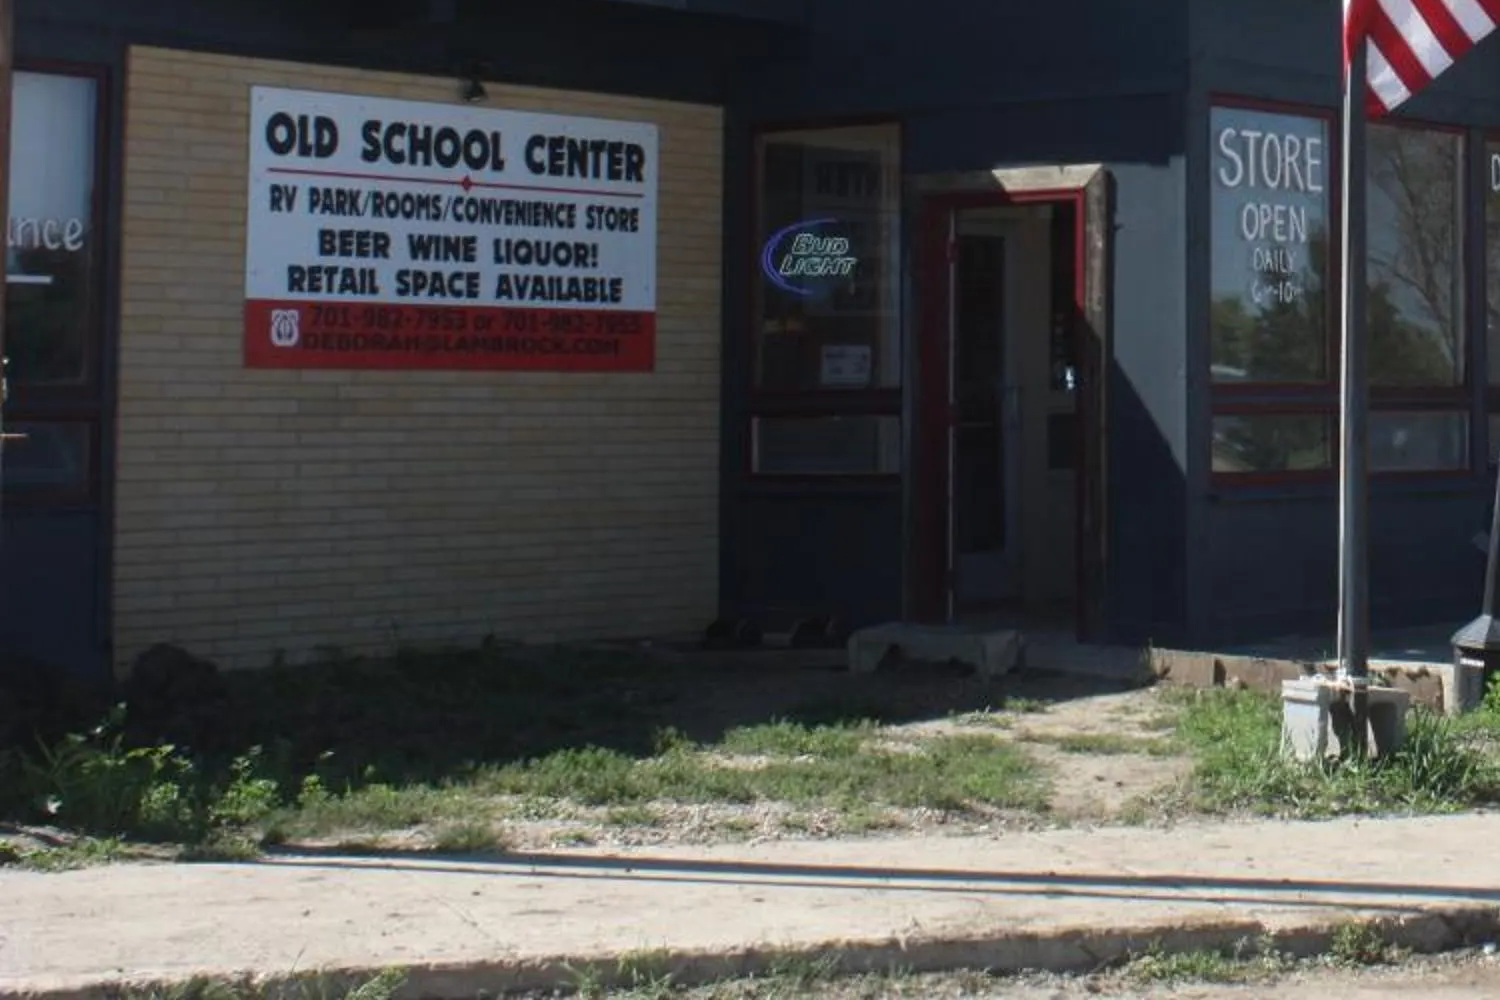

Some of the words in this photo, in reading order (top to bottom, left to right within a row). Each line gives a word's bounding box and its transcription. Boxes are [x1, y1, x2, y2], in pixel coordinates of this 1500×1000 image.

[265, 111, 339, 158] OLD
[361, 119, 505, 172] SCHOOL
[524, 134, 646, 183] CENTER
[1218, 127, 1324, 193] STORE
[269, 183, 298, 213] RV
[585, 203, 640, 233] STORE
[1241, 202, 1307, 243] OPEN
[318, 228, 391, 259] BEER
[408, 233, 478, 263] WINE
[493, 238, 600, 269] LIQUOR!
[1252, 246, 1298, 274] DAILY
[287, 264, 380, 295] RETAIL
[394, 269, 481, 299] SPACE
[495, 274, 623, 304] AVAILABLE
